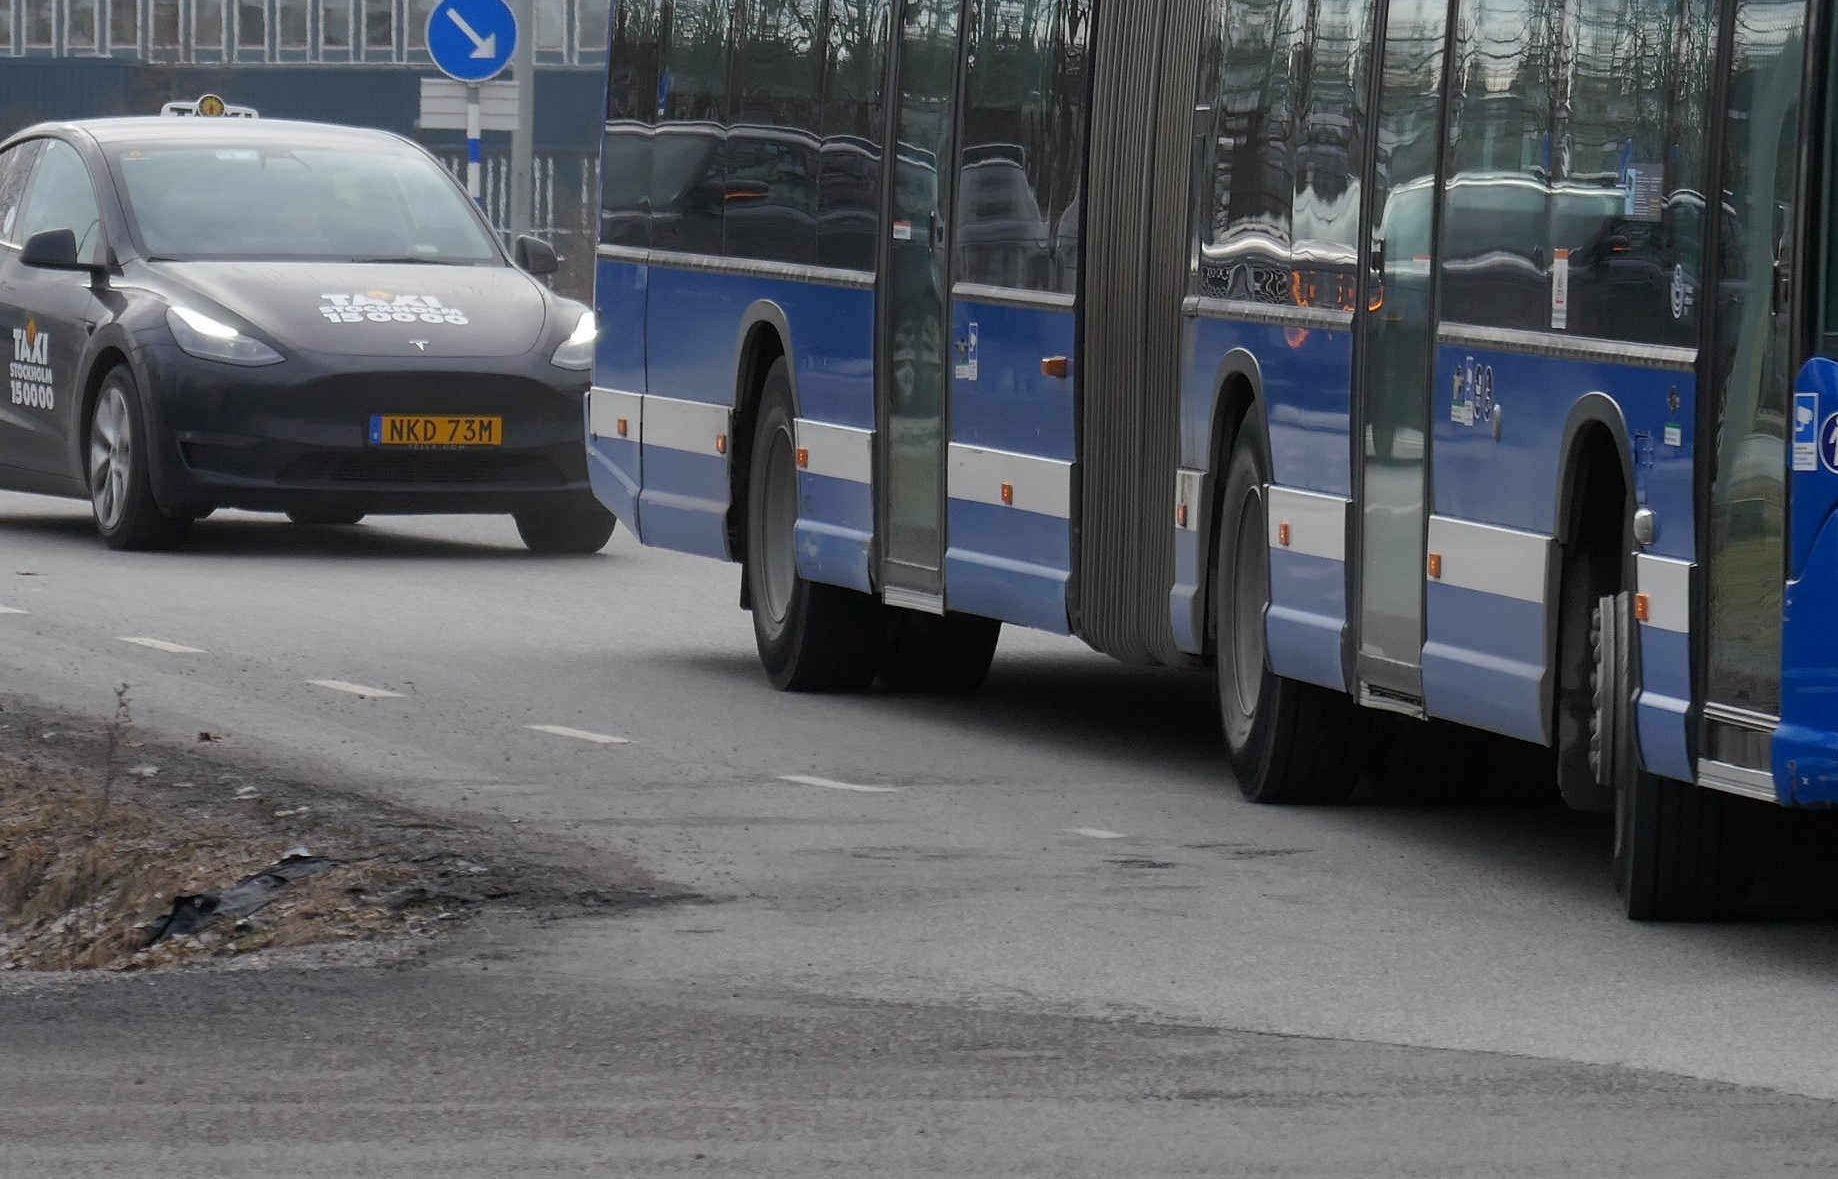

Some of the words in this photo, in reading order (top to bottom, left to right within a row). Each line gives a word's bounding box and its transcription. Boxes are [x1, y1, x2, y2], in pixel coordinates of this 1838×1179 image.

[318, 306, 464, 316] STOCKHOLM
[320, 294, 442, 308] TAXI
[12, 328, 48, 365] TAXI
[9, 362, 53, 385] STOCKHOLM
[390, 419, 437, 442] NKD
[447, 419, 493, 442] 73M
